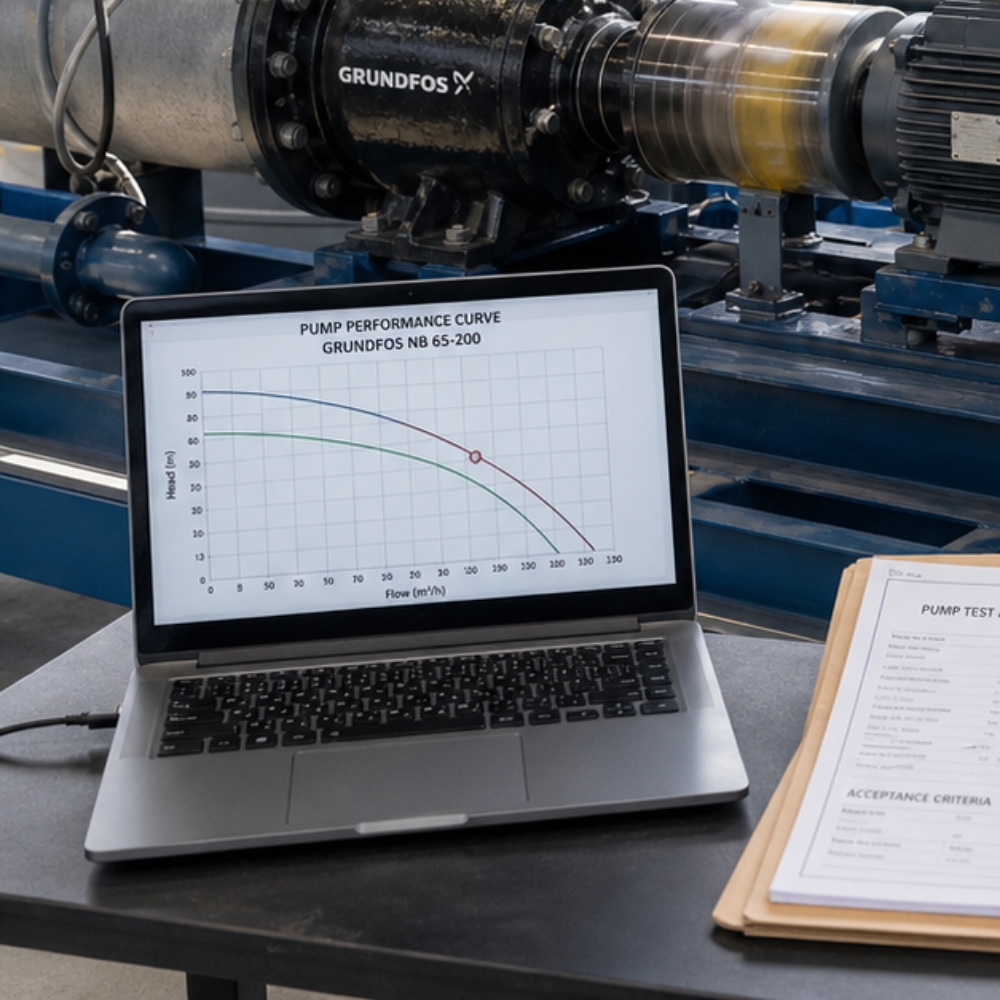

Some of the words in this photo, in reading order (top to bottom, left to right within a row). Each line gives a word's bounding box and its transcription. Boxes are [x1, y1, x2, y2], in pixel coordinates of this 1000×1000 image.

[338, 66, 449, 94] GRUNDFOS
[300, 321, 342, 336] PUMP
[346, 313, 451, 333] PERFORMANCE
[454, 311, 501, 326] CURVE
[322, 337, 403, 355] GRUNDFOS
[407, 335, 428, 349] NB
[432, 332, 481, 347] 65-200
[386, 588, 410, 600] Flow
[921, 604, 961, 617] PUMP
[964, 606, 995, 618] TEST
[846, 788, 930, 804] ACCEPTANCE
[933, 793, 992, 807] CRITERIA
